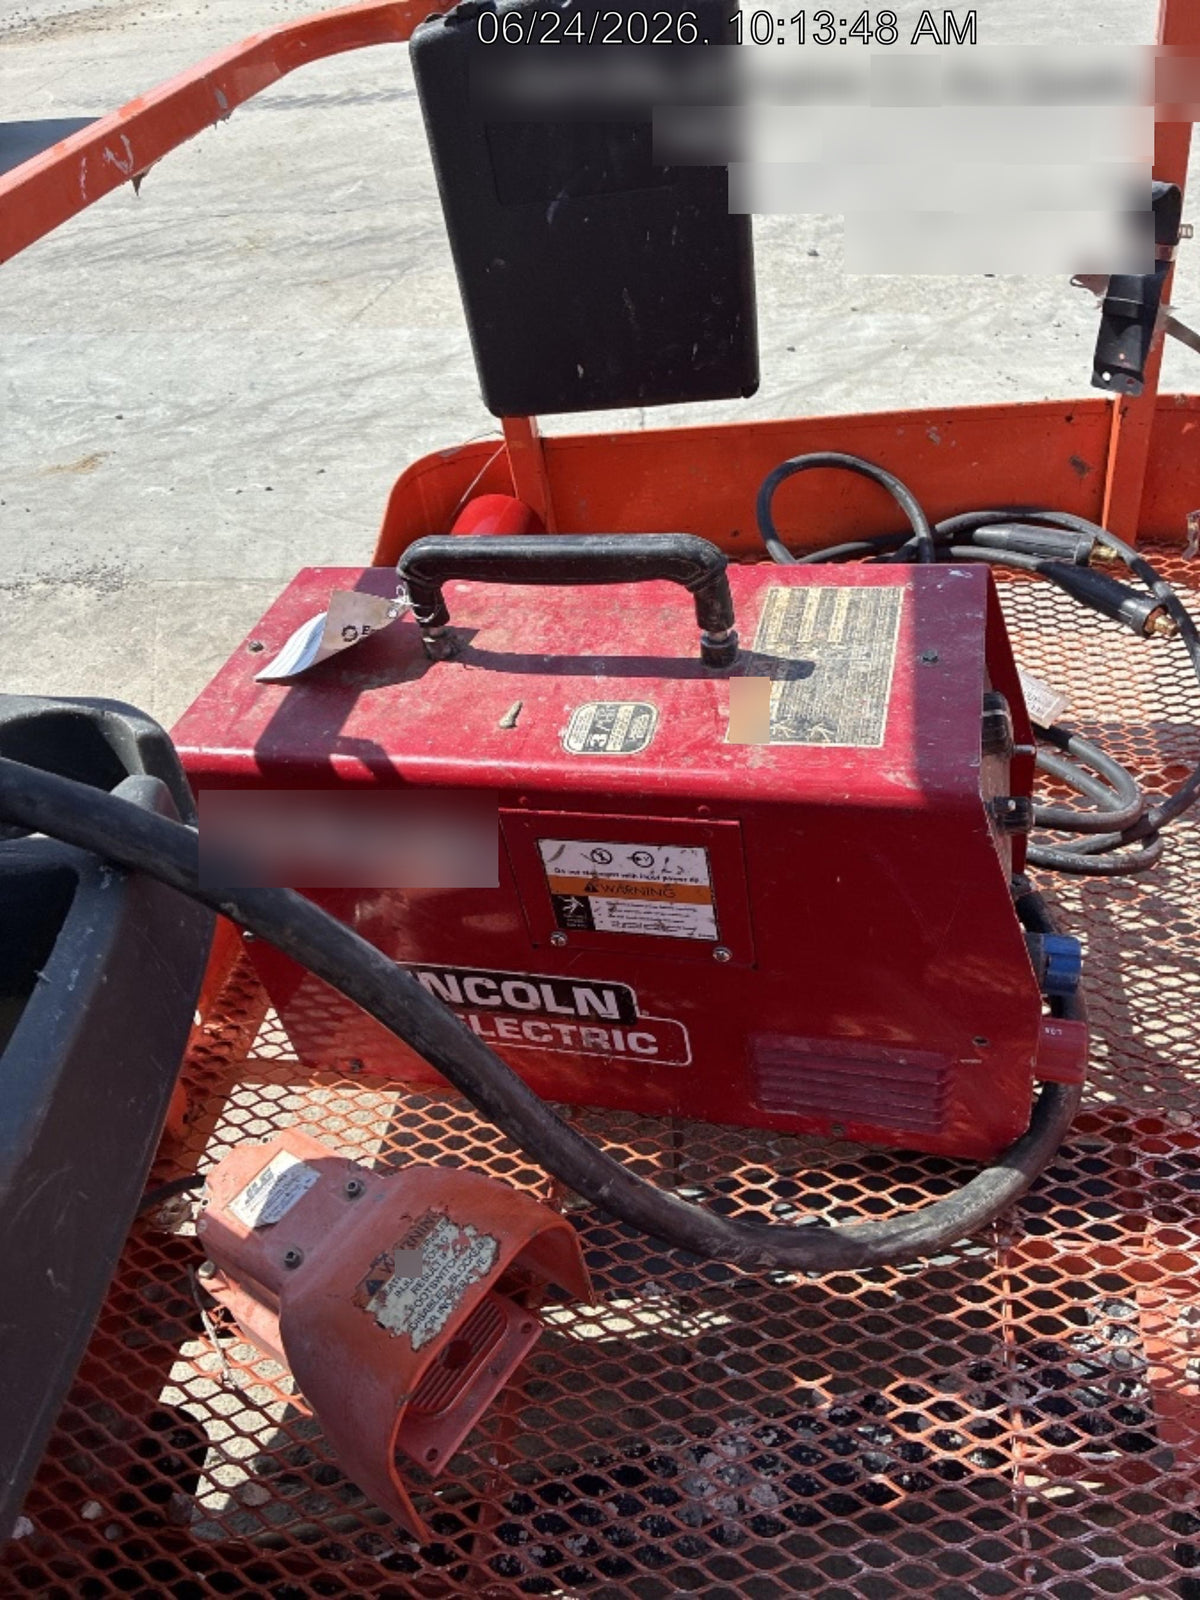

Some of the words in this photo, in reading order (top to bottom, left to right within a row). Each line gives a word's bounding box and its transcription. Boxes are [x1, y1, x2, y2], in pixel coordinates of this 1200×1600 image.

[602, 882, 676, 900] WARNING
[406, 970, 620, 1019] NCOLN
[455, 1013, 659, 1054] LECTRIC
